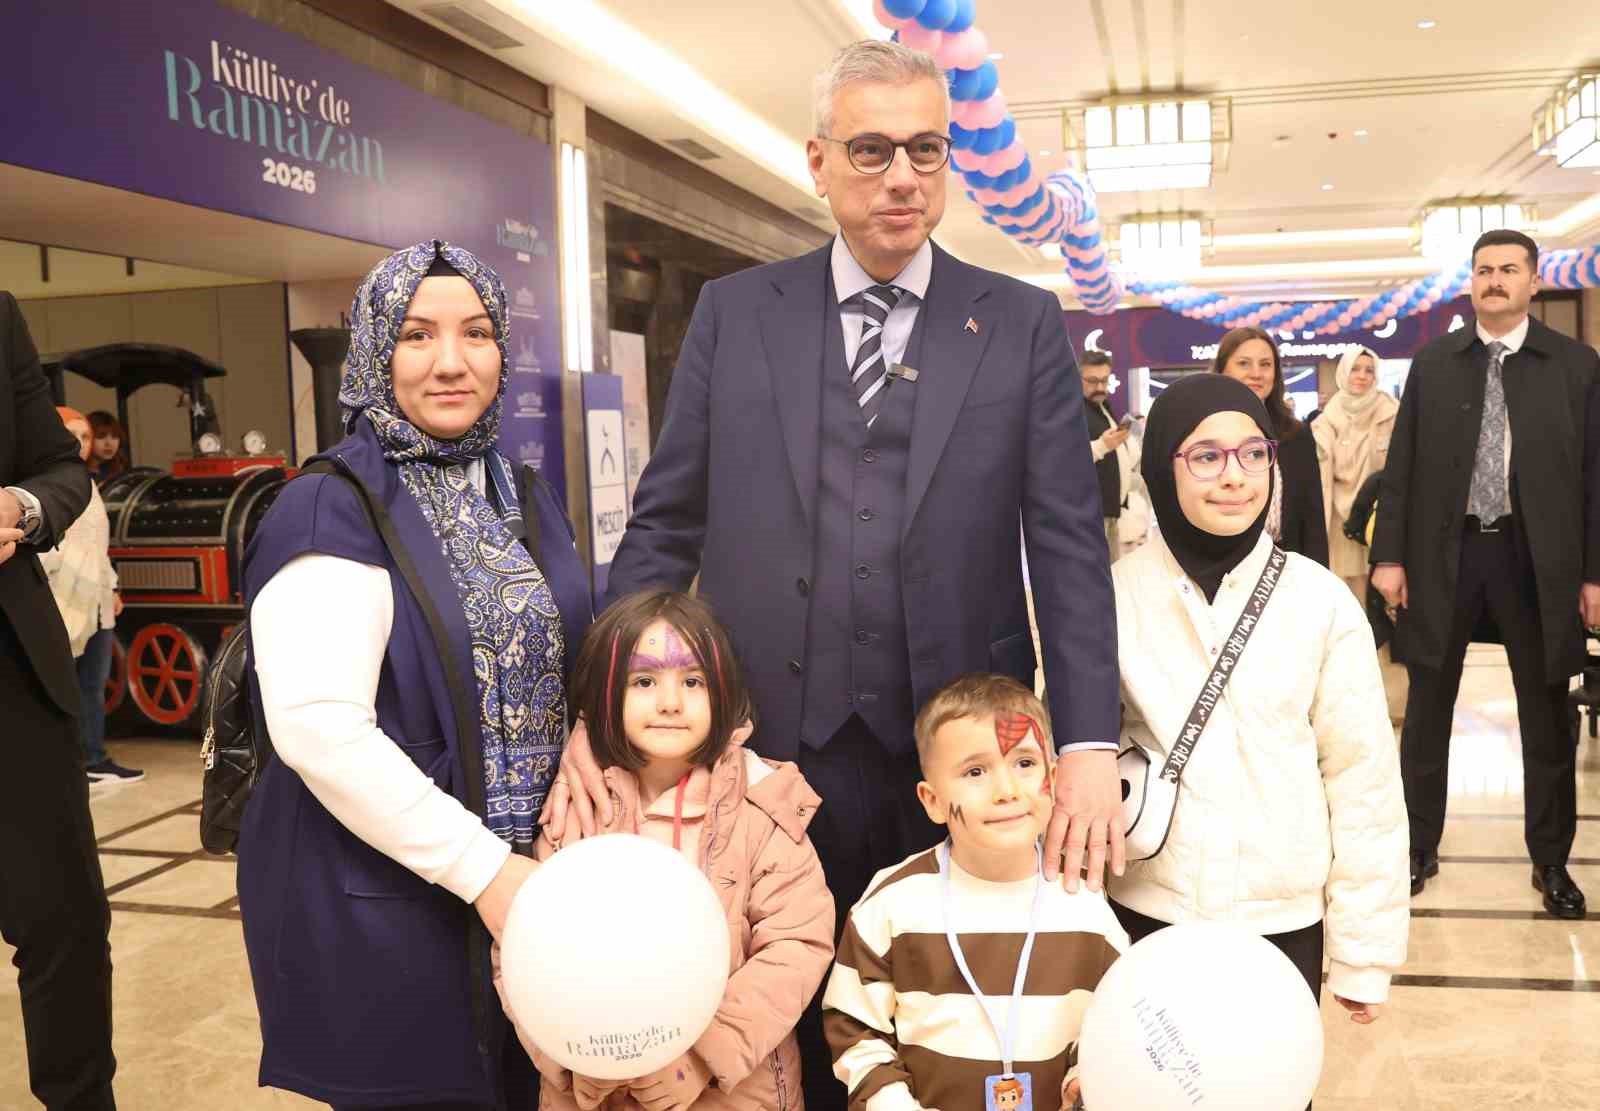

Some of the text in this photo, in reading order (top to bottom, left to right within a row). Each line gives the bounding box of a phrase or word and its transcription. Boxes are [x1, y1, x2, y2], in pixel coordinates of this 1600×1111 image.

[164, 49, 386, 184] Ramazan
[210, 40, 352, 127] külliye'de
[262, 157, 318, 194] 2026
